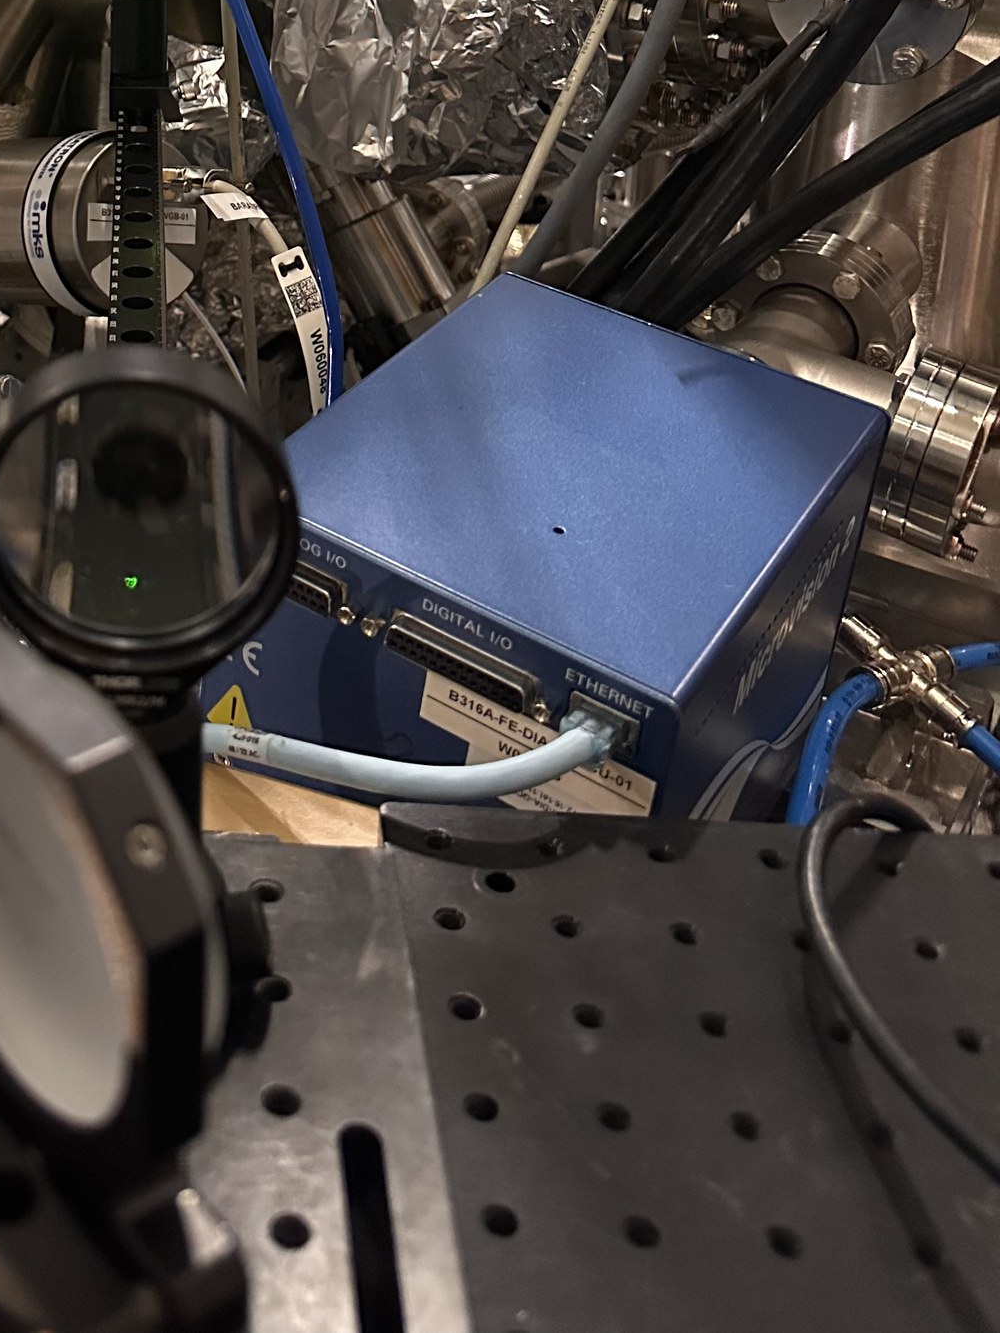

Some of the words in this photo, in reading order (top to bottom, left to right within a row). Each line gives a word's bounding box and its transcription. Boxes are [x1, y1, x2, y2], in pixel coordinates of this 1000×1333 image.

[31, 212, 44, 259] mks
[300, 537, 321, 557] OG
[326, 550, 347, 569] I/O
[422, 598, 484, 639] DIGITAL
[490, 631, 513, 651] I/O
[565, 668, 654, 719] ETHERNET
